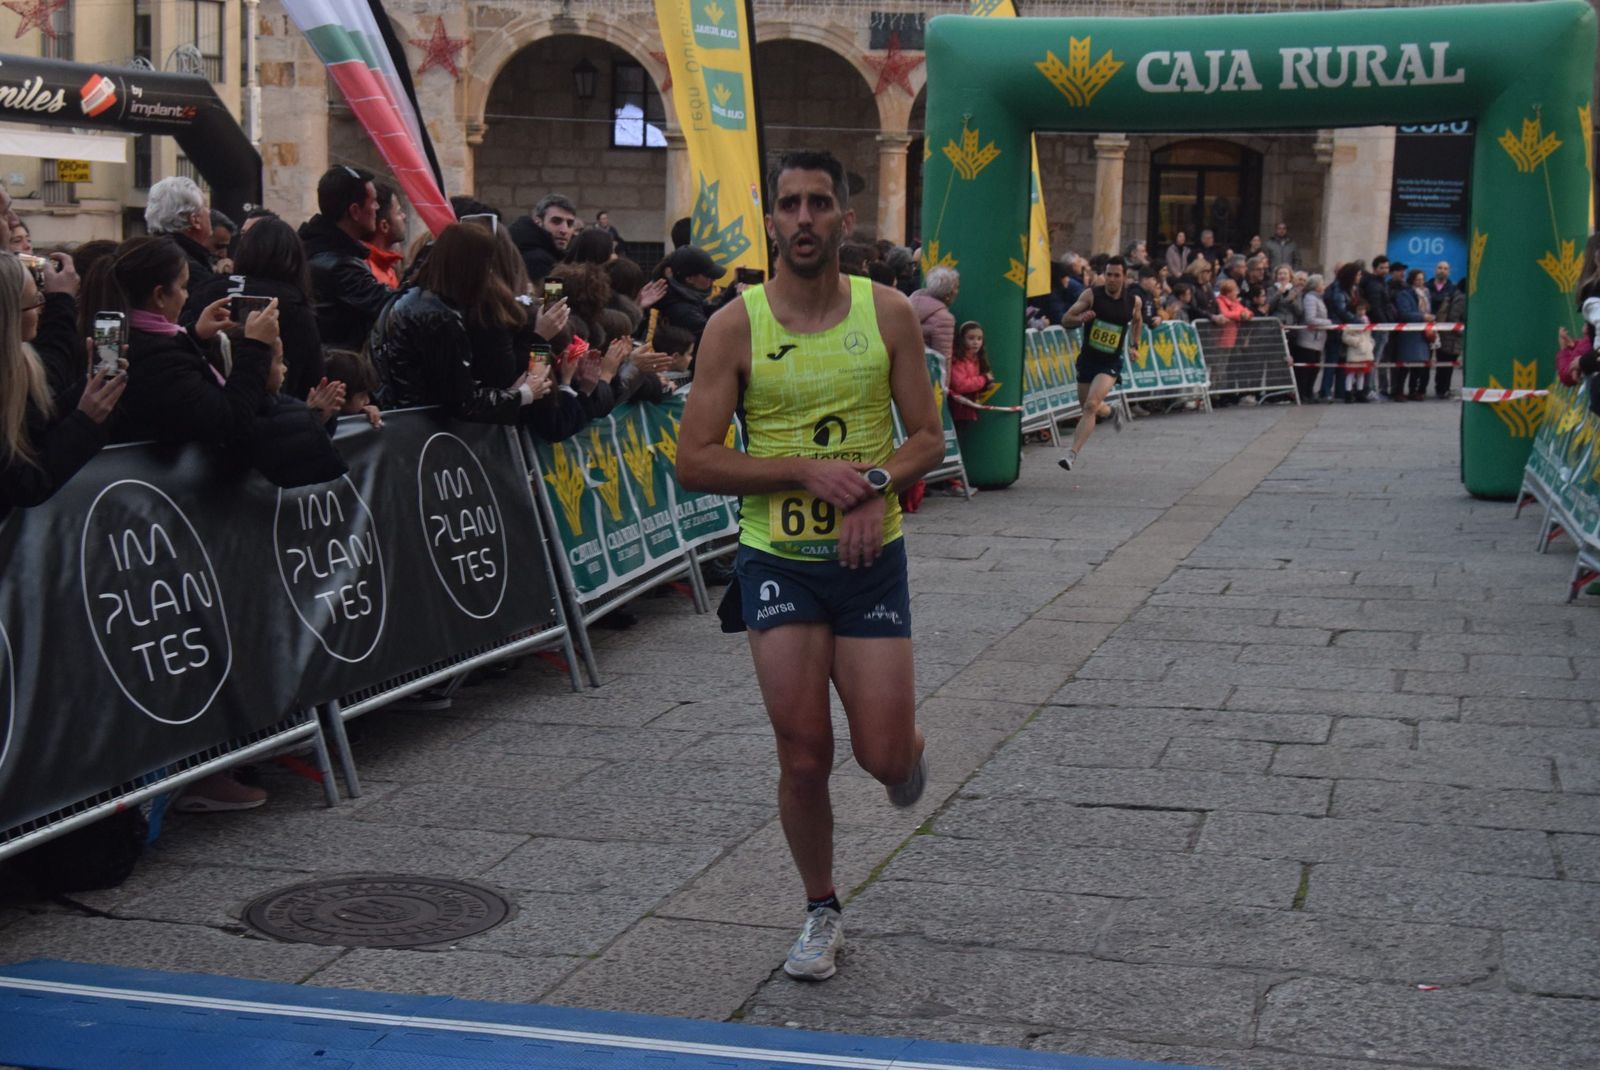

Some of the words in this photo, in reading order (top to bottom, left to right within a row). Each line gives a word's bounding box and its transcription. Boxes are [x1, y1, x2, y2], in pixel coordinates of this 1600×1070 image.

[1136, 50, 1262, 94] CAJA
[1279, 41, 1465, 90] RURAL
[131, 85, 143, 98] by
[1408, 236, 1444, 255] 016
[1092, 329, 1117, 346] 688
[434, 466, 473, 501] IM
[298, 490, 344, 531] IM
[430, 504, 497, 547] PLAN
[109, 523, 177, 571] IM
[287, 531, 373, 584] PLAN
[451, 547, 497, 584] TES
[801, 546, 830, 554] CAJA
[98, 571, 213, 634] PLAN
[314, 580, 372, 624] TES
[757, 602, 796, 621] Adarsa
[131, 627, 210, 681] TES
